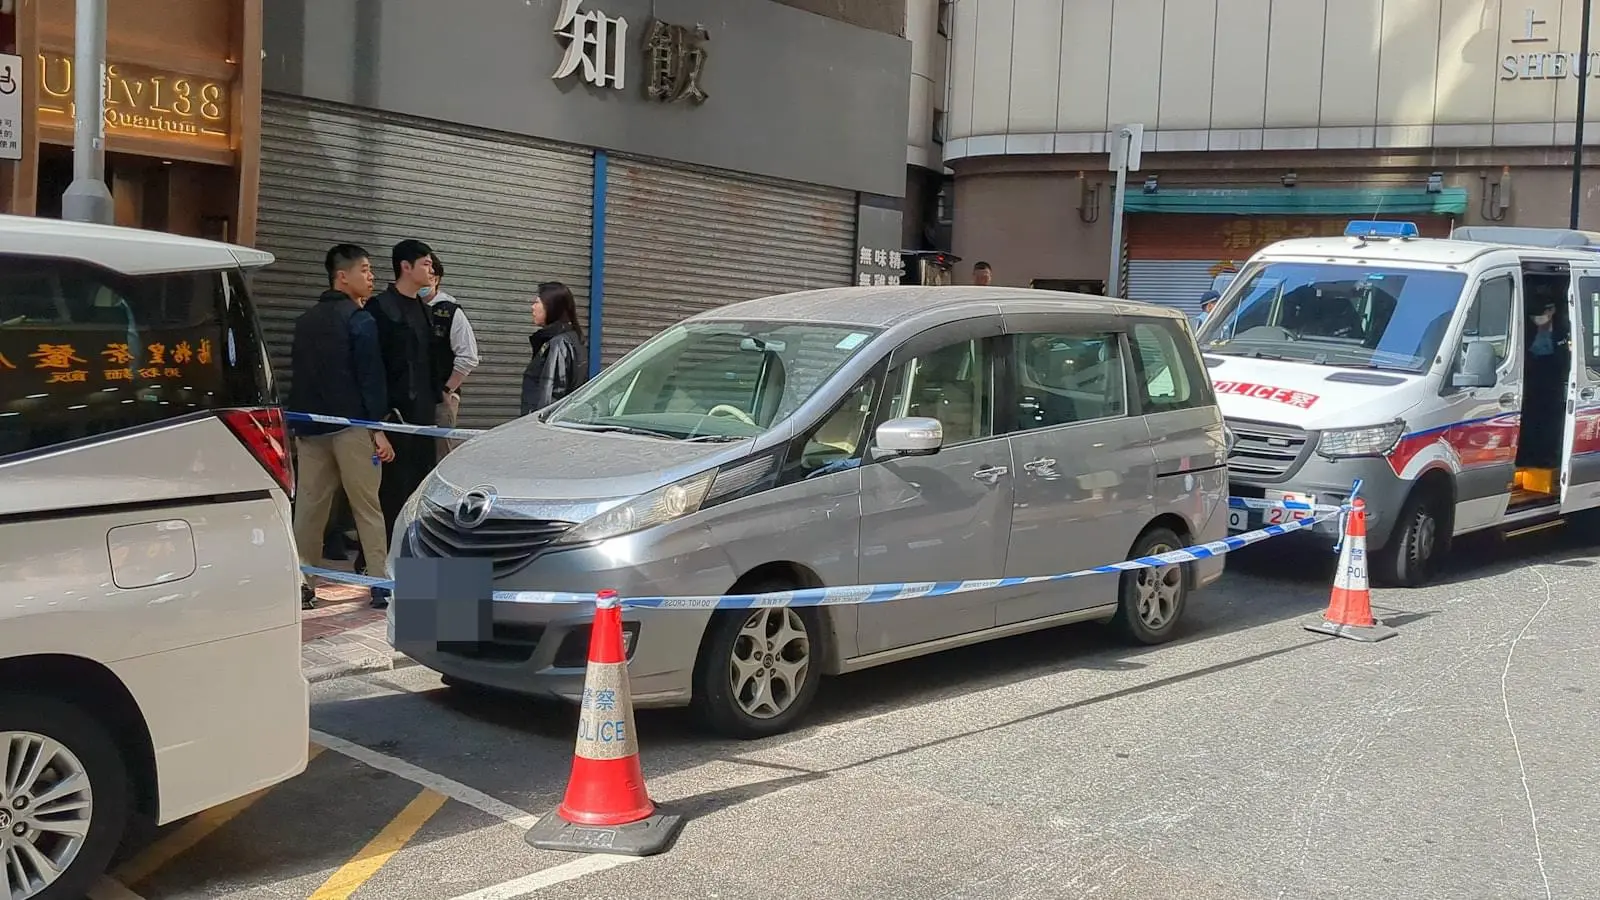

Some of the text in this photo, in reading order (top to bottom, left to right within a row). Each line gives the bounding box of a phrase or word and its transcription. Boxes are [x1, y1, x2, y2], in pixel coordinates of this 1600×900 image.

[1511, 8, 1549, 43] 上
[1501, 52, 1600, 81] SHEU
[38, 53, 222, 120] Uiv138
[104, 107, 198, 136] Quantum
[860, 247, 901, 269] 無味精
[1213, 381, 1292, 403] OLICE
[1347, 567, 1367, 579] POL
[579, 718, 625, 743] OLICE
